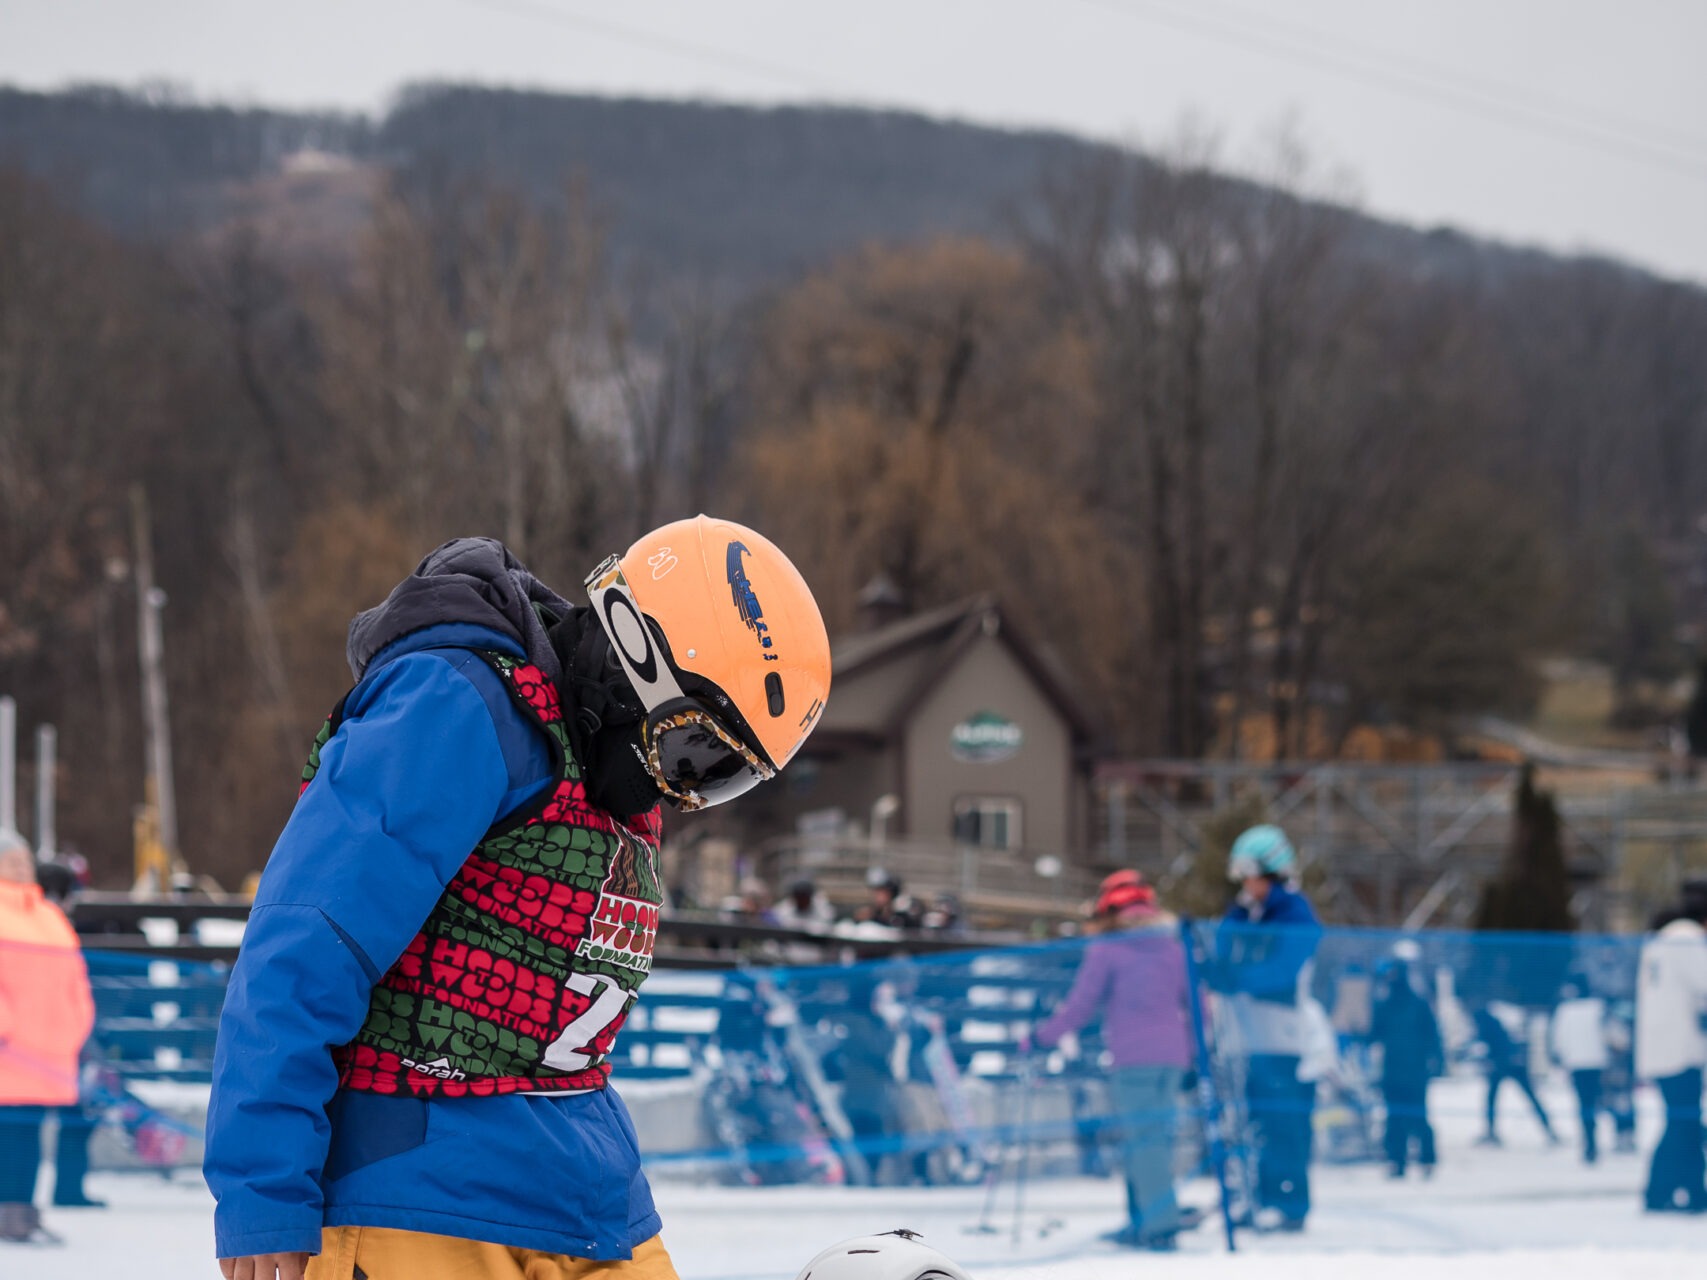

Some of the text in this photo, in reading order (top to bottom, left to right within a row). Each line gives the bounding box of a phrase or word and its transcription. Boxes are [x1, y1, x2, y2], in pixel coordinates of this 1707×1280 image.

[452, 879, 579, 951] FOUNDATION
[461, 865, 586, 934] WOODS
[430, 961, 552, 1024] WOODS
[433, 938, 556, 1000] HOODS
[478, 970, 504, 990] TO
[419, 999, 538, 1060] HOODS
[423, 984, 548, 1041] FOUNDATION
[464, 1030, 487, 1048] TO
